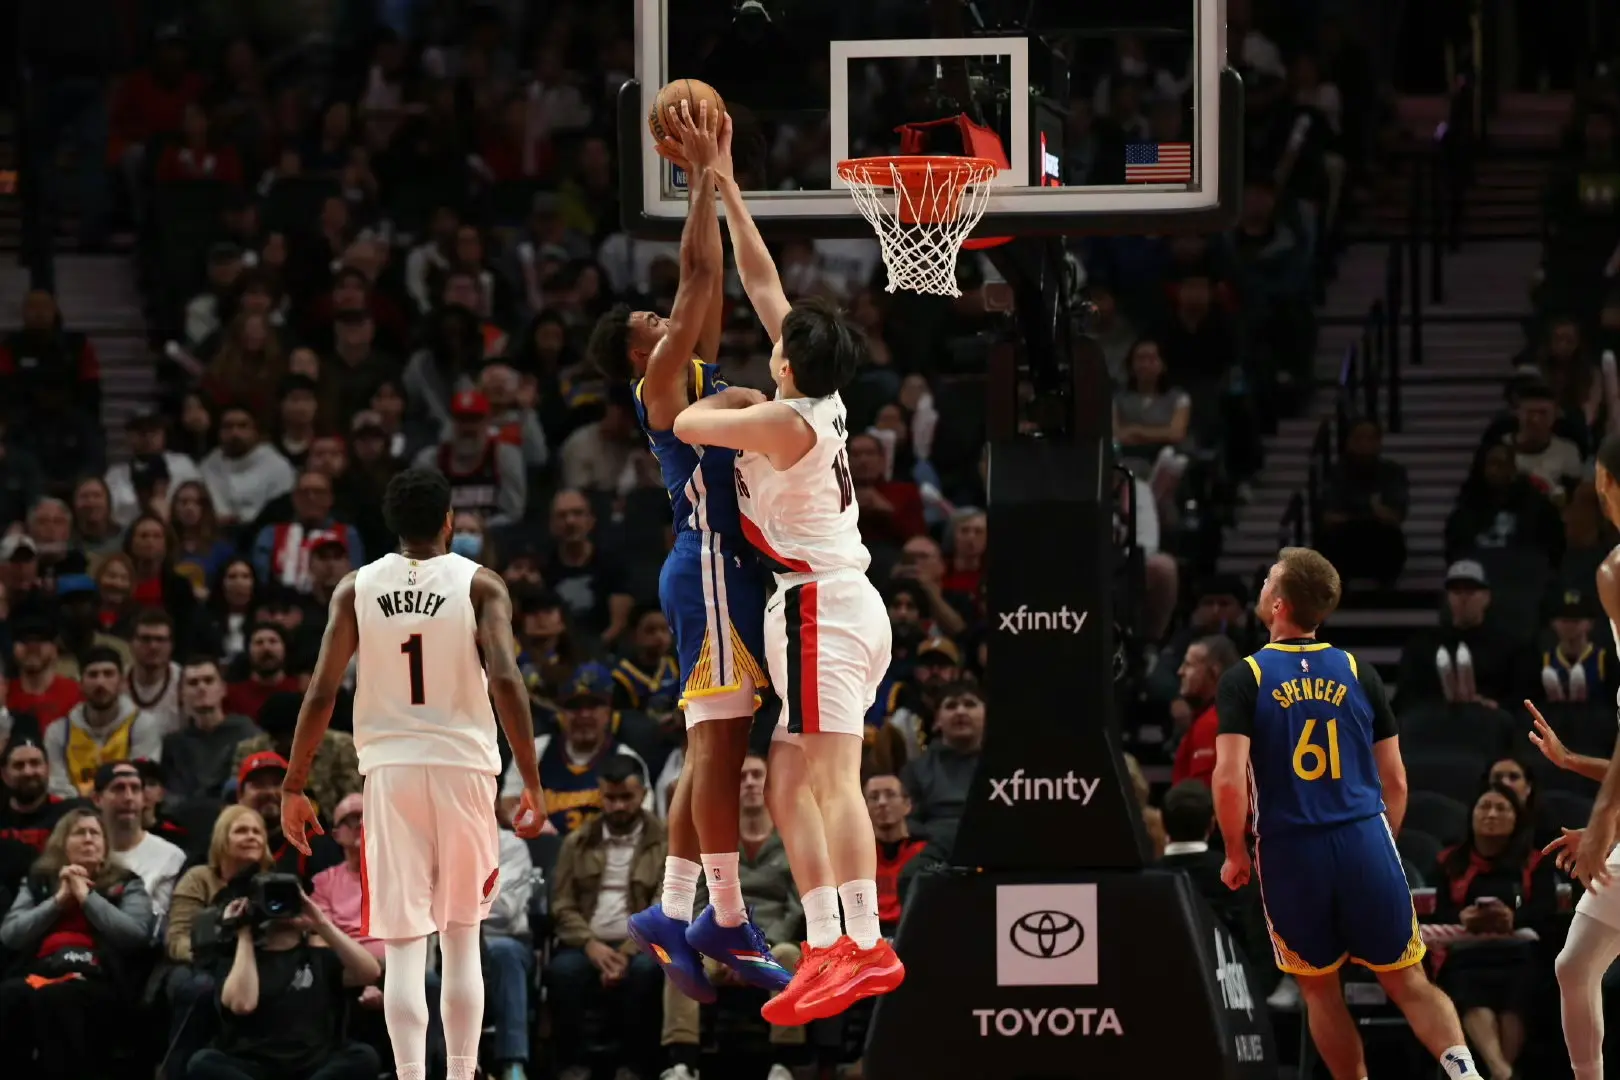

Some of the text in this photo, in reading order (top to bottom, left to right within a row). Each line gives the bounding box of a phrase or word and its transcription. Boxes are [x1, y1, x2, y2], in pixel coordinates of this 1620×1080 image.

[831, 447, 853, 514] 16
[377, 590, 447, 618] WESLEY
[999, 604, 1088, 635] xfinity
[401, 633, 426, 705] 1
[1271, 677, 1348, 709] SPENCER
[1292, 717, 1341, 781] 61
[988, 768, 1101, 806] xfinity
[972, 1007, 1124, 1036] TOYOTA
